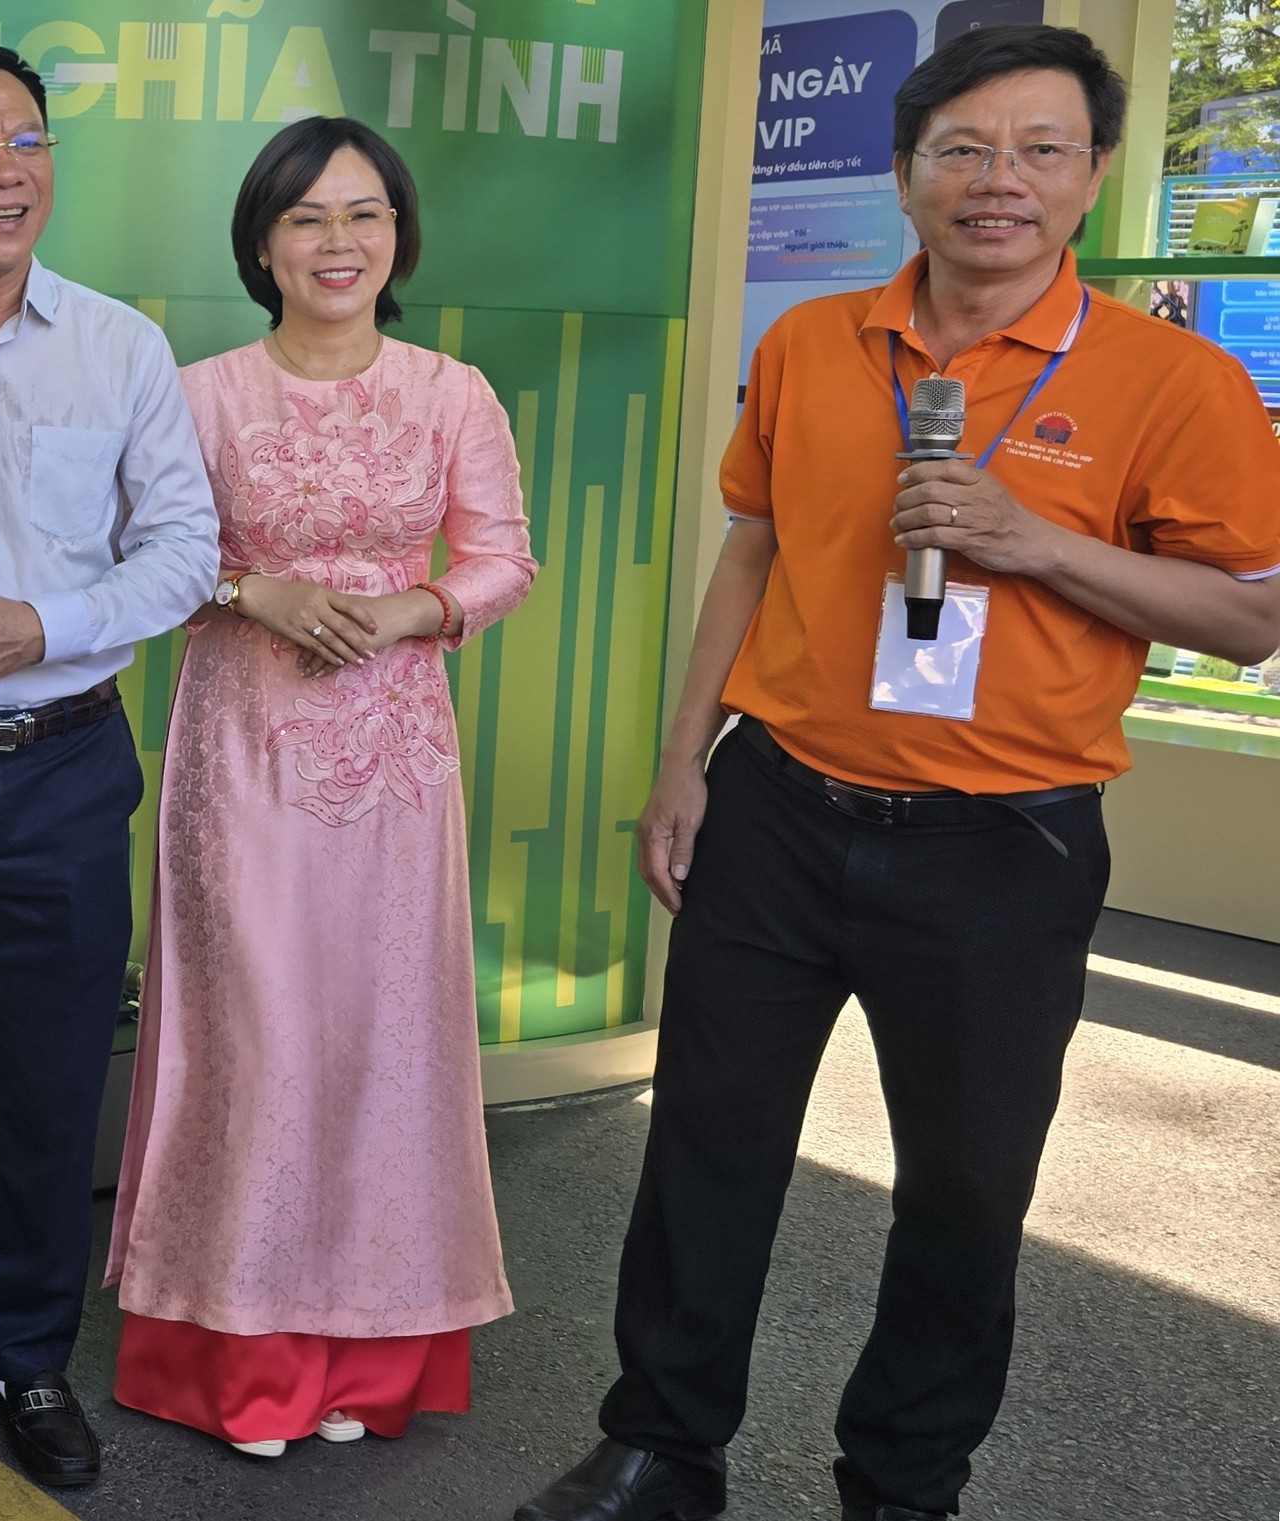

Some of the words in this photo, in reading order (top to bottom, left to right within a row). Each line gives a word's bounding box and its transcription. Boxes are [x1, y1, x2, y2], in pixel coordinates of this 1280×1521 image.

[369, 0, 624, 144] TÌNH
[770, 55, 872, 102] NGÀY
[758, 117, 816, 149] VIP
